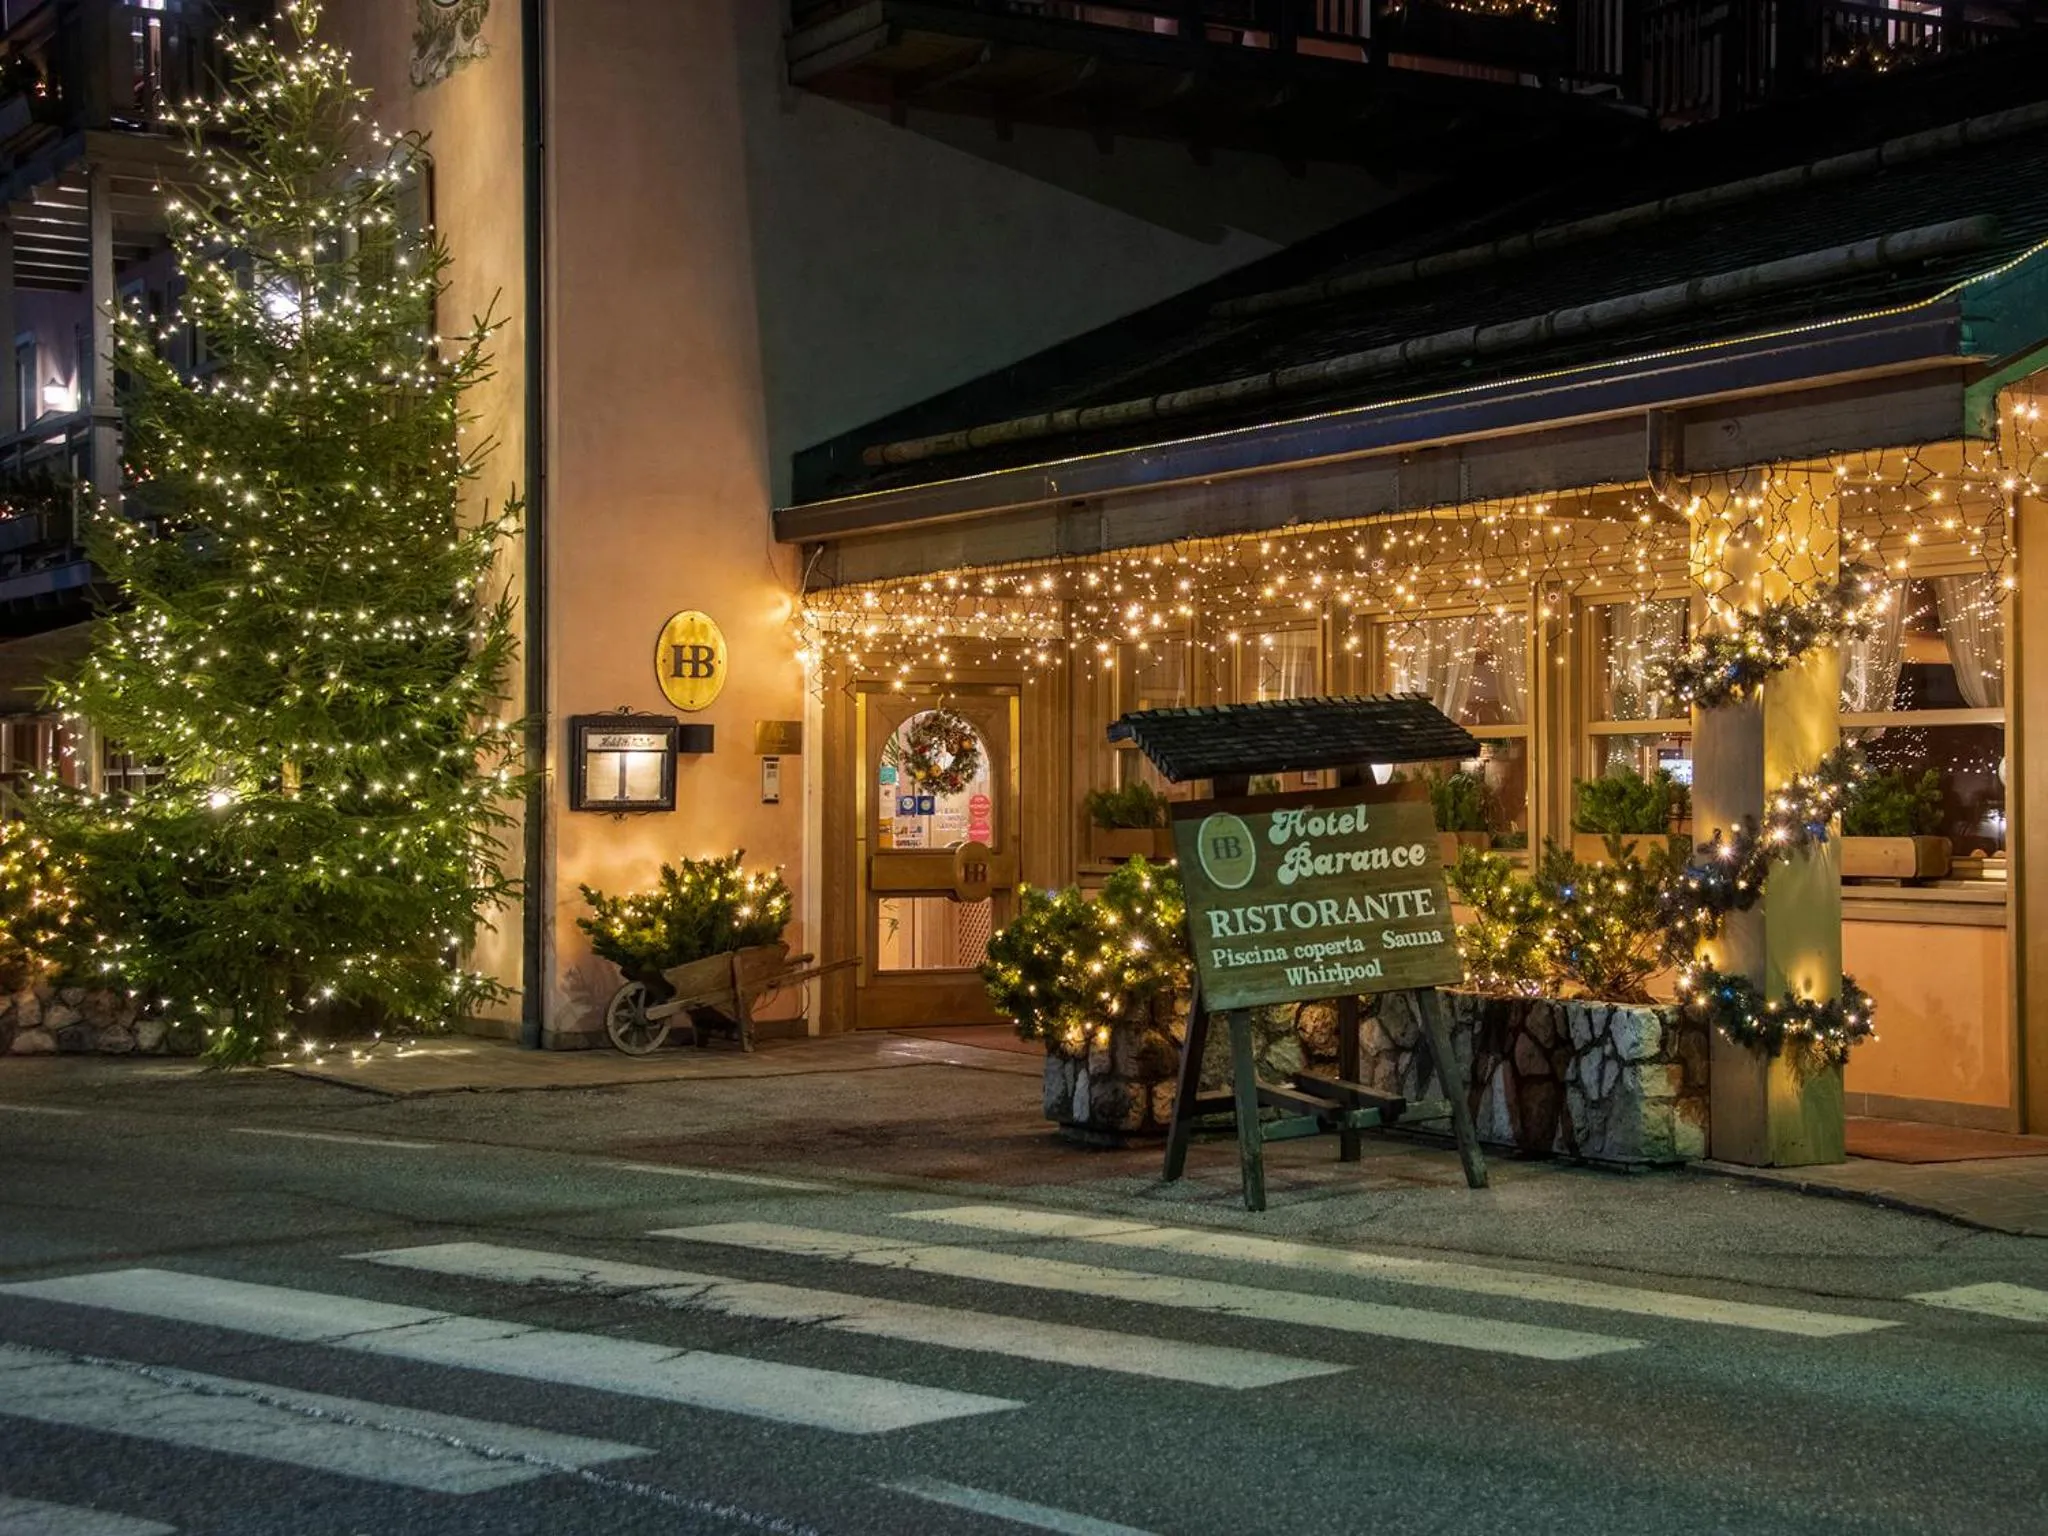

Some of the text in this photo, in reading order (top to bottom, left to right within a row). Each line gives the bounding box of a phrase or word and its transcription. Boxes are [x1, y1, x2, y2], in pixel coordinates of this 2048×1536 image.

[670, 645, 715, 678] HB
[1268, 804, 1370, 845] Hotel
[1212, 836, 1243, 860] HB
[1277, 842, 1427, 885] Barance
[1206, 889, 1436, 938] RISTORANTE
[1211, 929, 1444, 968] Piscina coperta Sauna
[1285, 959, 1383, 987] Whirlpool
